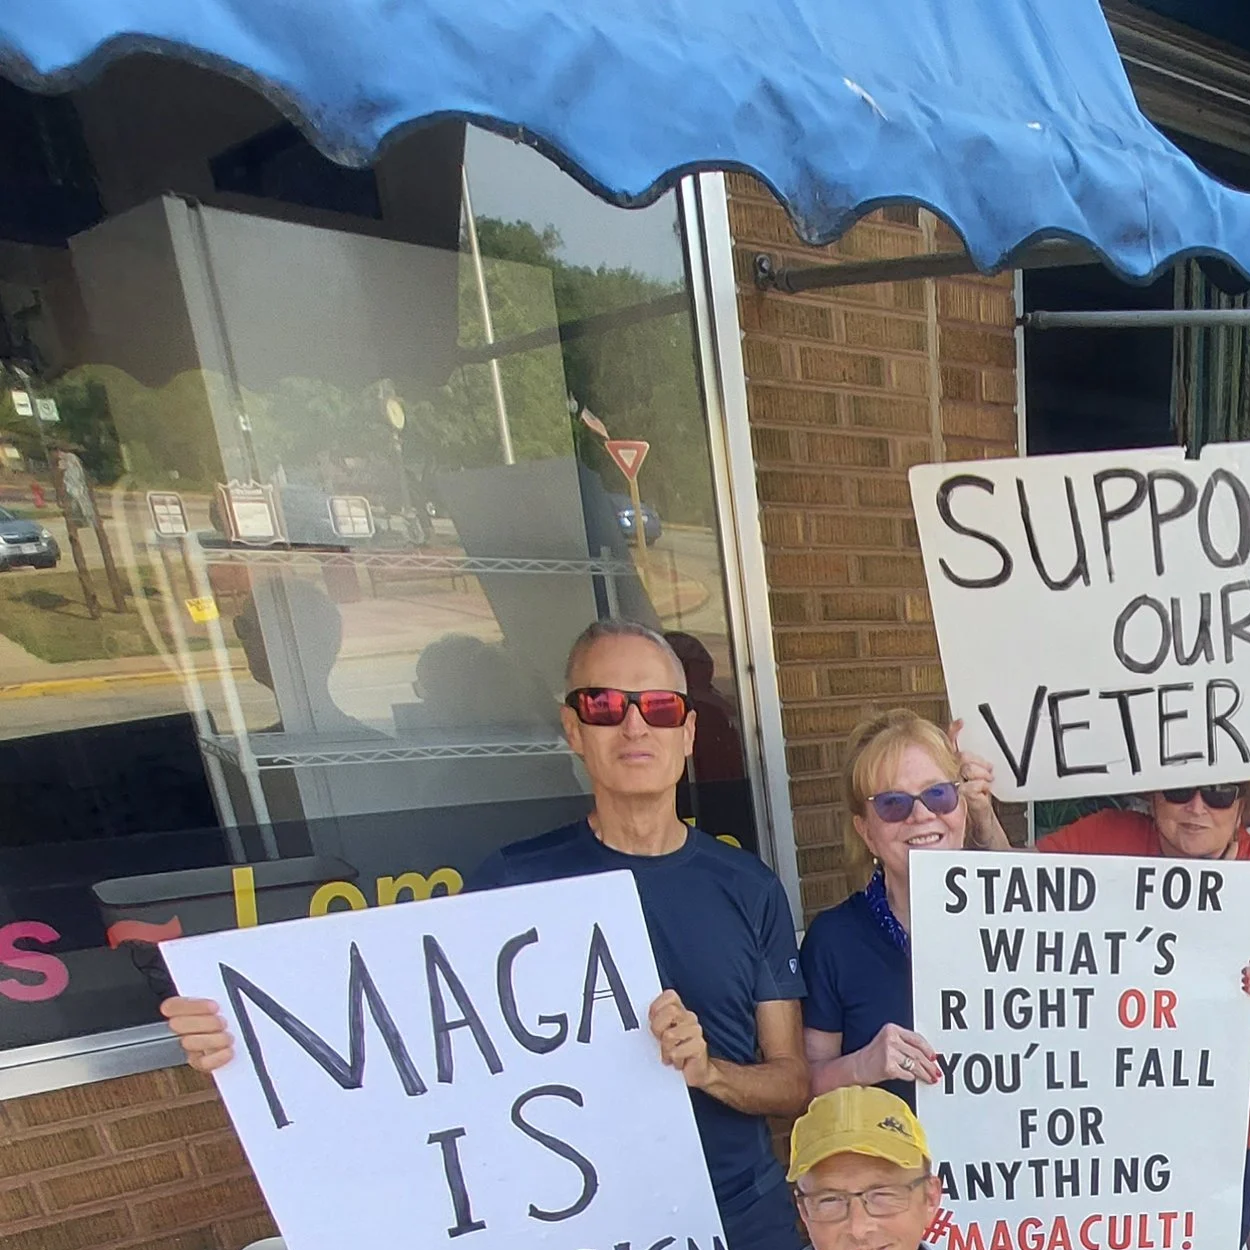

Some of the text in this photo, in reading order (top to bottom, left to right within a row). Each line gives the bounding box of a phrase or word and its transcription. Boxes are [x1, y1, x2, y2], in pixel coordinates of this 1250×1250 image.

[944, 866, 1225, 915] STAND FOR
[979, 926, 1178, 976] WHAT'S
[218, 921, 641, 1129] MAGA
[941, 986, 1178, 1031] RIGHT OR
[936, 1042, 1216, 1096] YOU'LL FALL
[1018, 1106, 1105, 1149] FOR
[426, 1082, 600, 1239] IS
[936, 1153, 1171, 1202] ANYTHING
